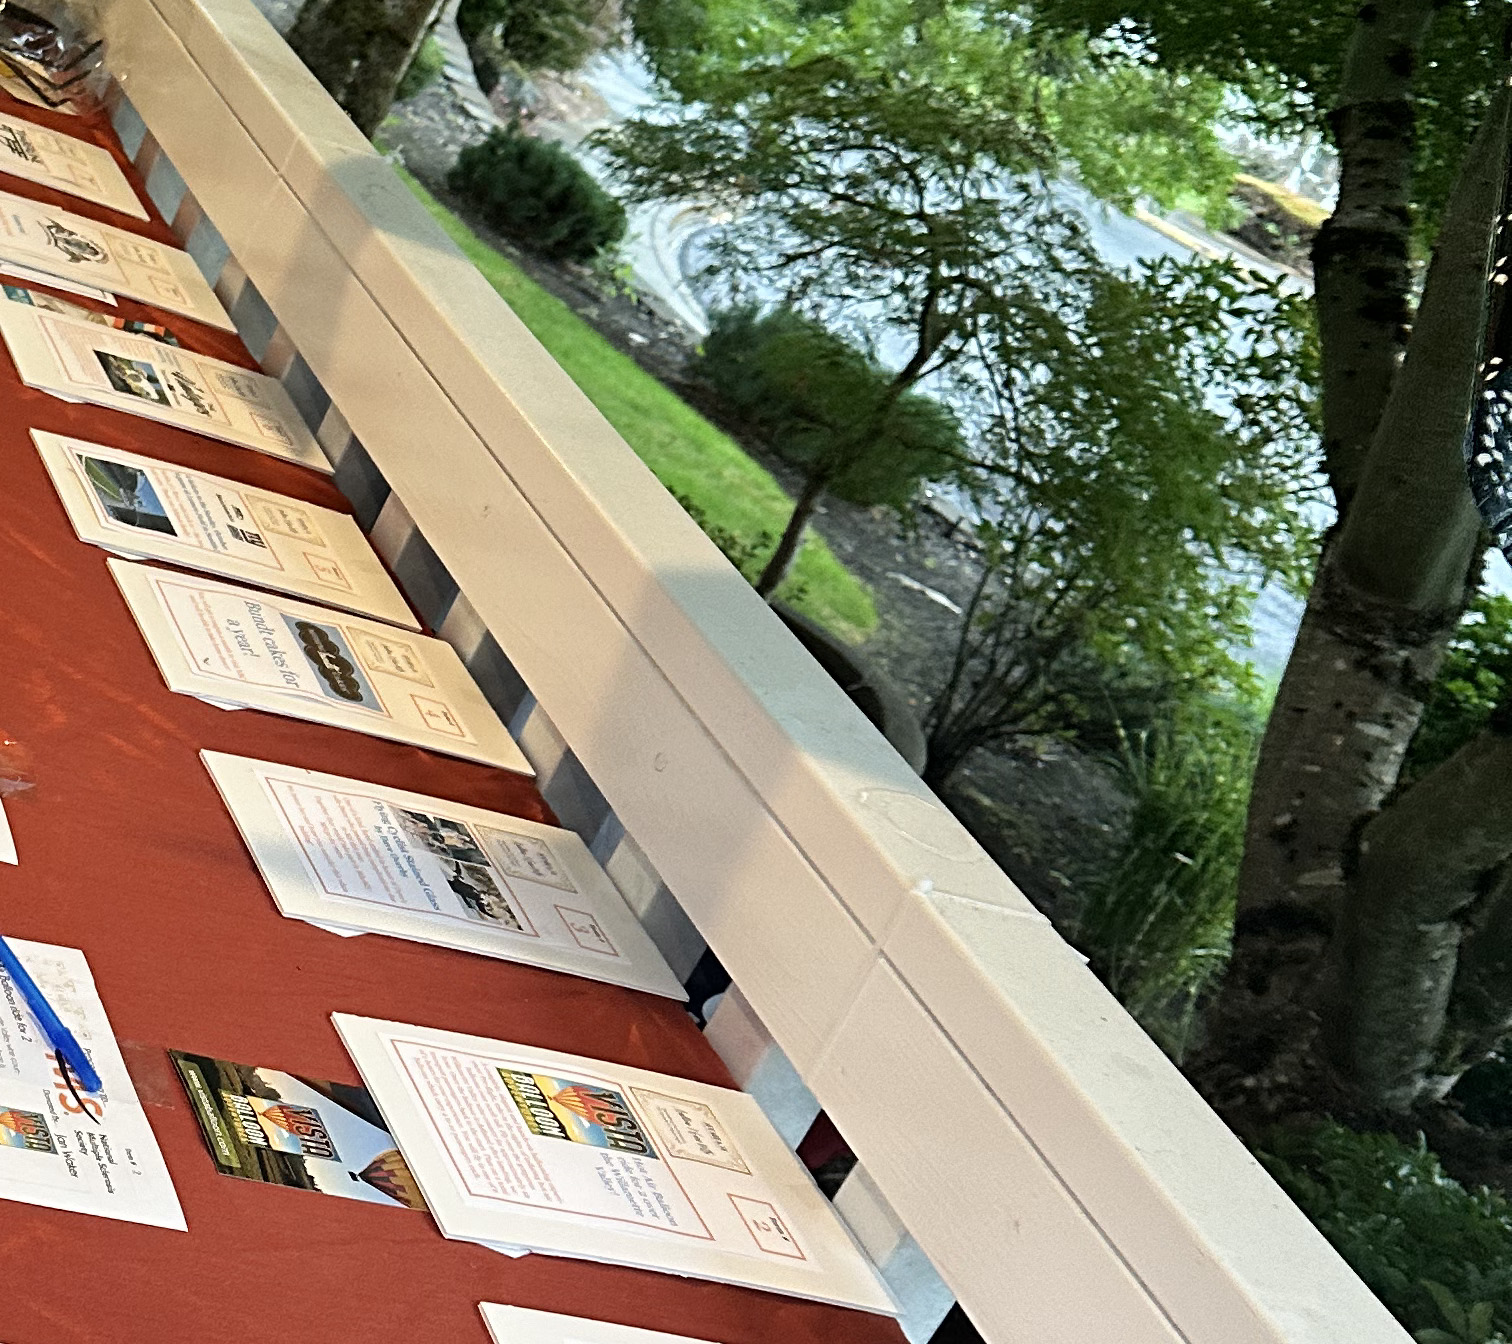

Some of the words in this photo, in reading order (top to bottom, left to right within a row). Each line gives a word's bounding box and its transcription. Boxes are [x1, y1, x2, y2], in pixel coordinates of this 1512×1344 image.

[226, 627, 259, 657] year!
[244, 601, 274, 635] Bundt
[262, 637, 287, 667] cakes
[279, 669, 299, 687] for
[372, 800, 391, 824] Flying
[387, 826, 408, 853] Cyclist
[403, 854, 429, 886] Stained
[423, 887, 439, 910] Glass
[569, 922, 590, 933] 3
[9, 1006, 22, 1021] ride
[16, 1022, 27, 1033] for
[43, 1053, 104, 1118] MS
[511, 1073, 566, 1138] BALLOON
[19, 1113, 52, 1152] VISTA
[188, 1069, 231, 1156] www.vistaballoon.com
[230, 1094, 267, 1146] BALLOON
[284, 1108, 334, 1158] VISTA
[580, 1092, 648, 1153] VISTA
[54, 1133, 67, 1148] Jan
[73, 1130, 87, 1155] Society
[86, 1132, 102, 1161] Multiple
[97, 1163, 114, 1193] Sclerosis
[98, 1134, 116, 1164] National
[595, 1166, 619, 1196] Valley!
[599, 1152, 613, 1167] the
[611, 1169, 643, 1216] Willamette
[616, 1156, 633, 1174] ride
[629, 1175, 642, 1189] for
[642, 1198, 659, 1219] over
[631, 1157, 647, 1173] Hot
[643, 1175, 656, 1189] Air
[652, 1191, 677, 1226] Balloon
[752, 1219, 771, 1232] 2
